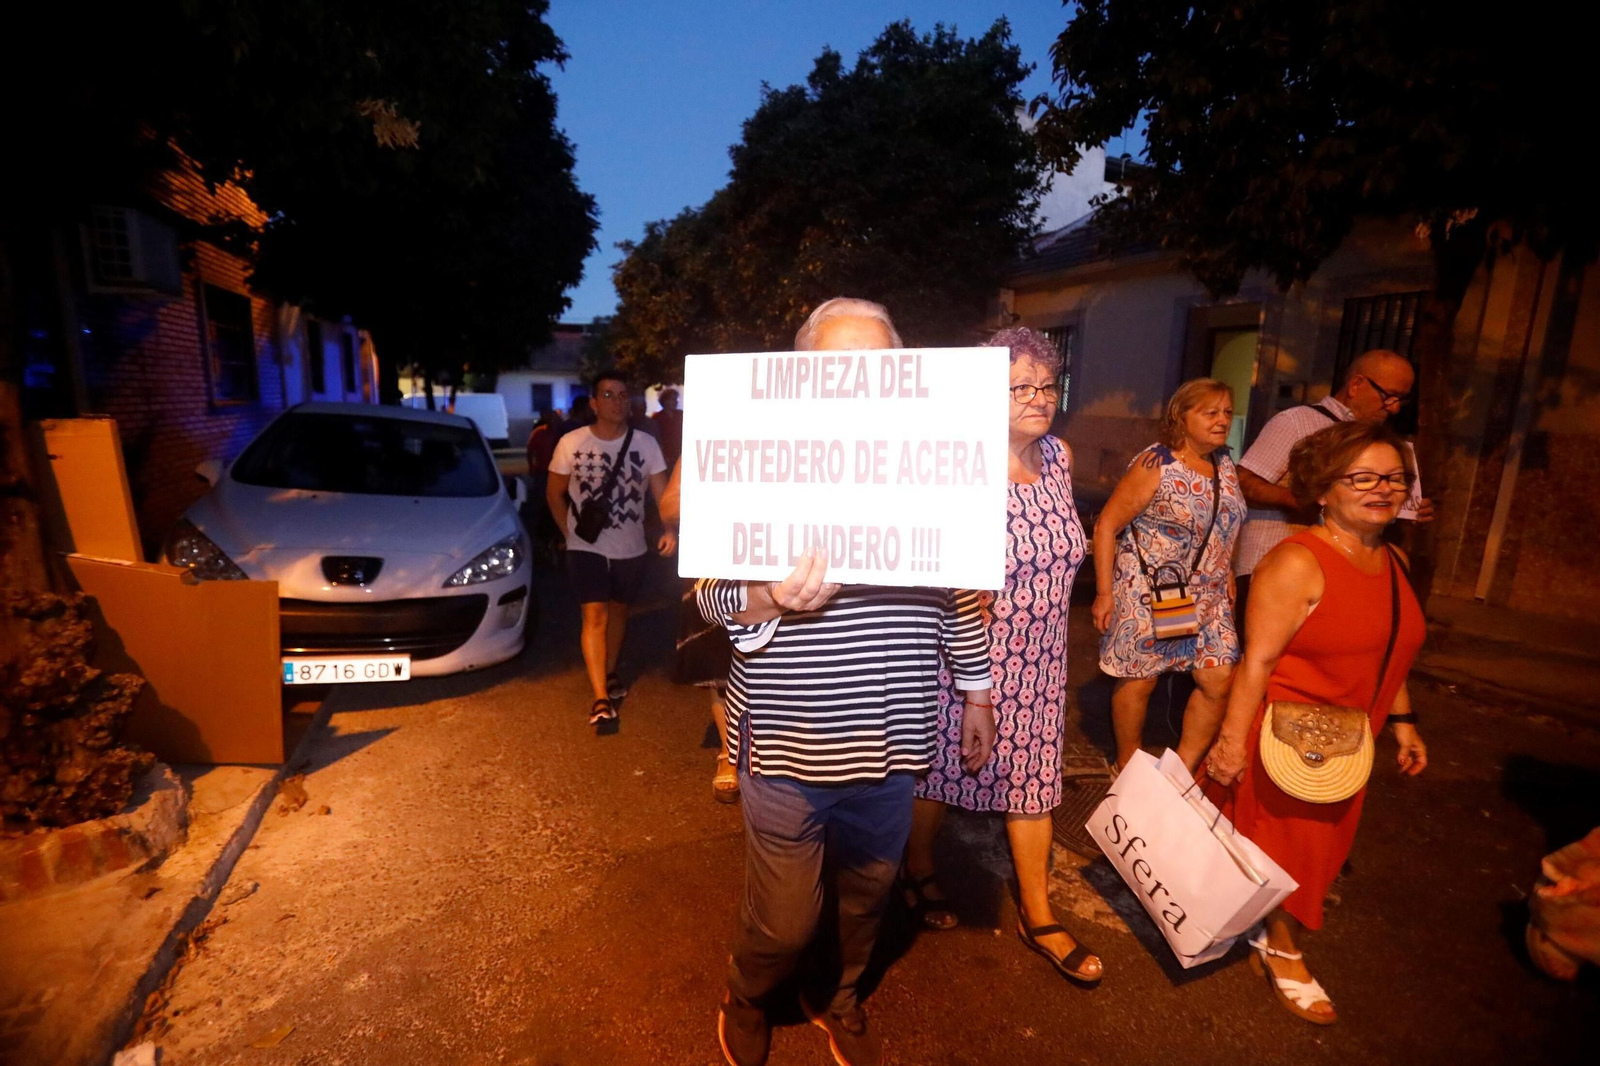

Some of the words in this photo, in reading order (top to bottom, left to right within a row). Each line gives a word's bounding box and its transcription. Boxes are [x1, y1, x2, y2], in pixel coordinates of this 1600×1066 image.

[751, 357, 870, 399] LIMPIEZA
[880, 355, 929, 398] DEL
[695, 439, 844, 483] VERTEDERO
[855, 440, 888, 484] DE
[896, 440, 988, 486] ACERA
[732, 522, 778, 566] DEL
[911, 527, 941, 572] !!!!
[300, 664, 355, 681] 8716
[1105, 814, 1187, 934] Sfera
